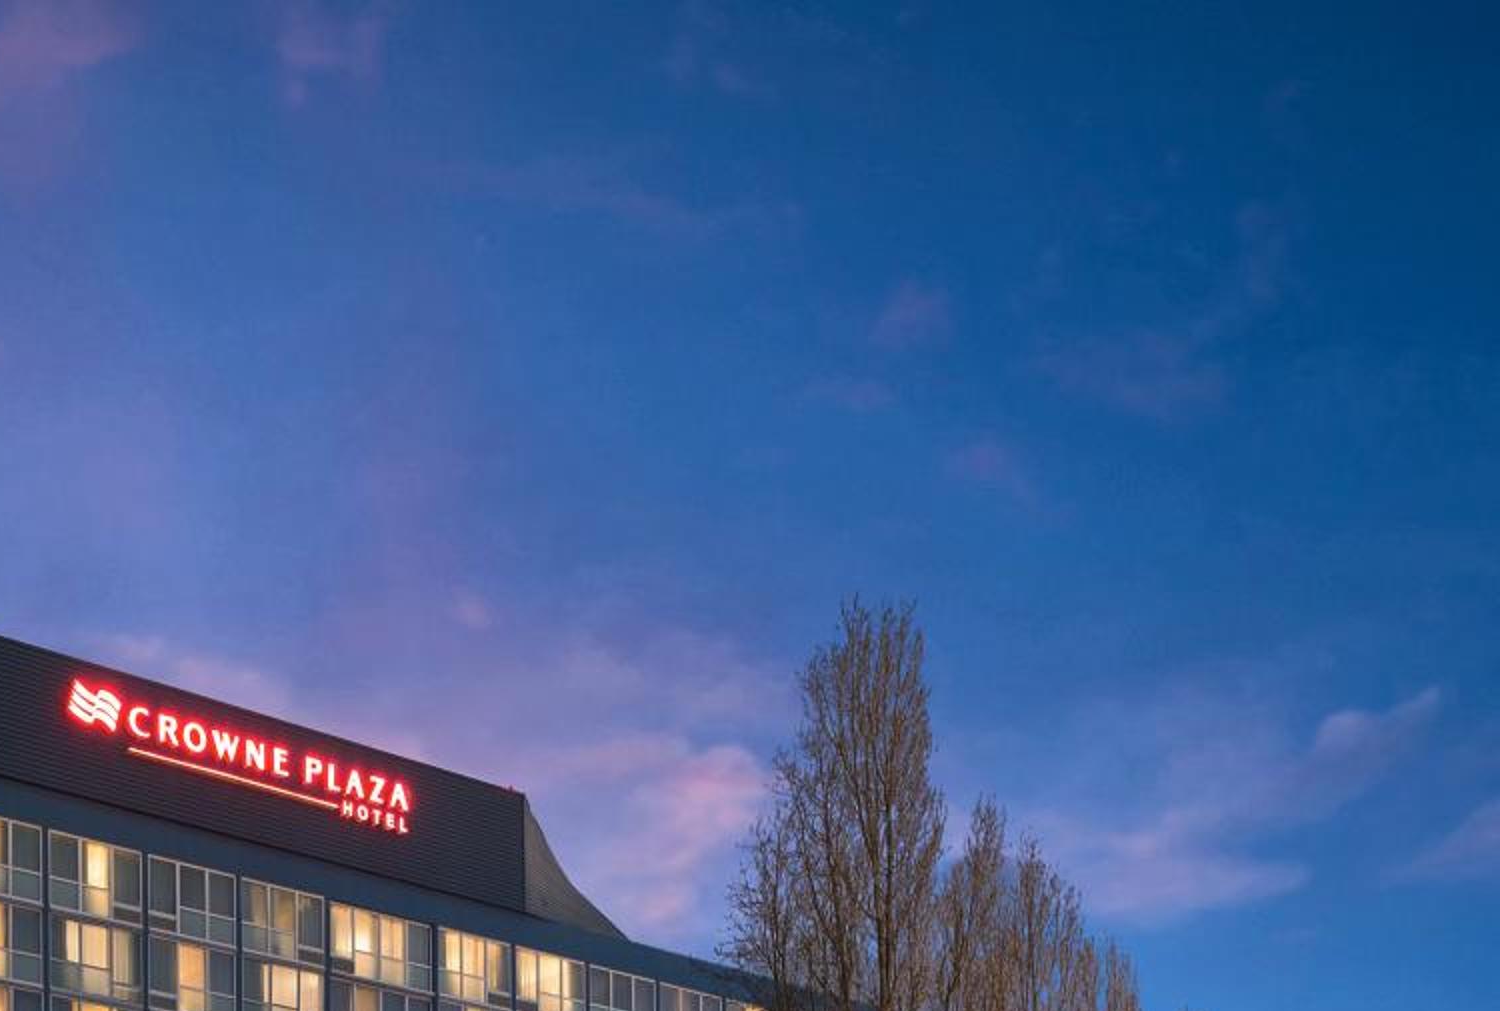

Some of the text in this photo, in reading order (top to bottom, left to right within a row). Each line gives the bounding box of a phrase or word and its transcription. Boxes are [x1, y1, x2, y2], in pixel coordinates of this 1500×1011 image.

[128, 706, 410, 811] CROWNE PLAZA
[341, 800, 409, 833] HOTEL
